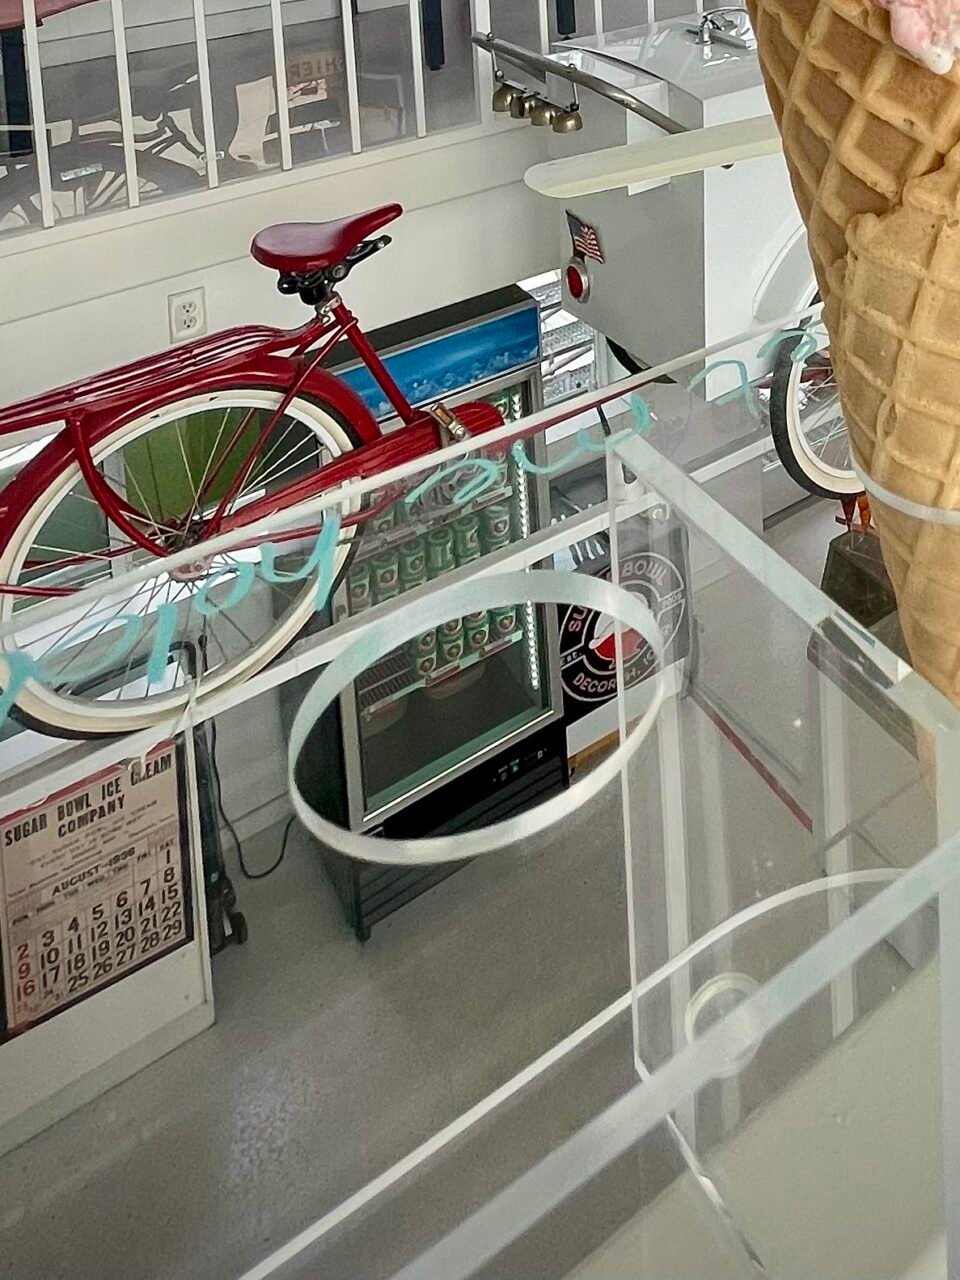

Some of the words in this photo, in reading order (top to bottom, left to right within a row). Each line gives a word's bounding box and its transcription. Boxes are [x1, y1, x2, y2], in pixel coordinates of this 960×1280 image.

[622, 559, 667, 586] BOWL
[4, 813, 48, 847] SUGAR
[57, 792, 92, 822] BOWL
[101, 776, 123, 801] ICE
[130, 753, 172, 786] CEAM
[58, 794, 125, 839] COMPANY
[166, 849, 171, 865] 1
[16, 979, 36, 1002] 16
[42, 964, 61, 989] 17
[67, 953, 86, 975] 18
[91, 939, 110, 962] 19
[115, 926, 136, 948] 20
[140, 914, 157, 935] 21
[161, 901, 182, 923] 22
[17, 942, 29, 961] 2
[42, 929, 55, 948] 3
[68, 917, 80, 933] 4
[92, 903, 104, 921] 5
[116, 891, 128, 908] 6
[140, 877, 152, 897] 7
[163, 867, 175, 883] 8
[18, 962, 31, 980] 9
[40, 947, 60, 971] 10
[68, 933, 82, 955] 11
[90, 921, 108, 942] 12
[115, 908, 132, 930] 13
[138, 895, 155, 917] 14
[161, 882, 179, 904] 15
[68, 970, 89, 994] 25
[92, 957, 113, 980] 26
[116, 944, 137, 967] 27
[140, 930, 160, 954] 28
[162, 919, 183, 941] 29
